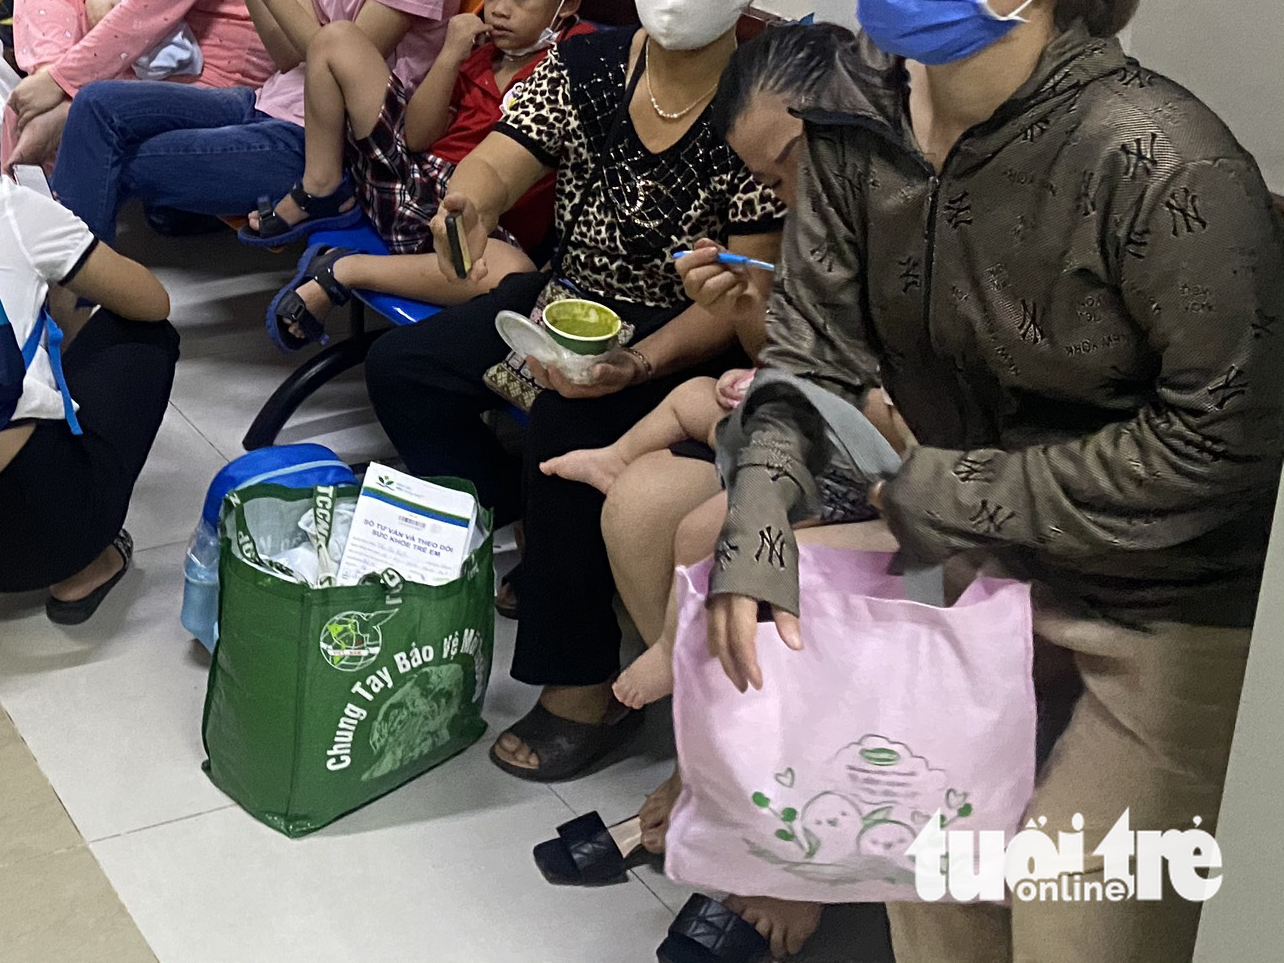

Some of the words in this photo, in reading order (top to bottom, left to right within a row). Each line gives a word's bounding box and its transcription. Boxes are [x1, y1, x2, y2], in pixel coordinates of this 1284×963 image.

[417, 537, 437, 549] THEO
[429, 549, 441, 557] EM
[326, 702, 367, 771] Chung
[351, 666, 394, 702] Tay
[393, 641, 434, 674] Bảo
[442, 631, 459, 660] Vệ
